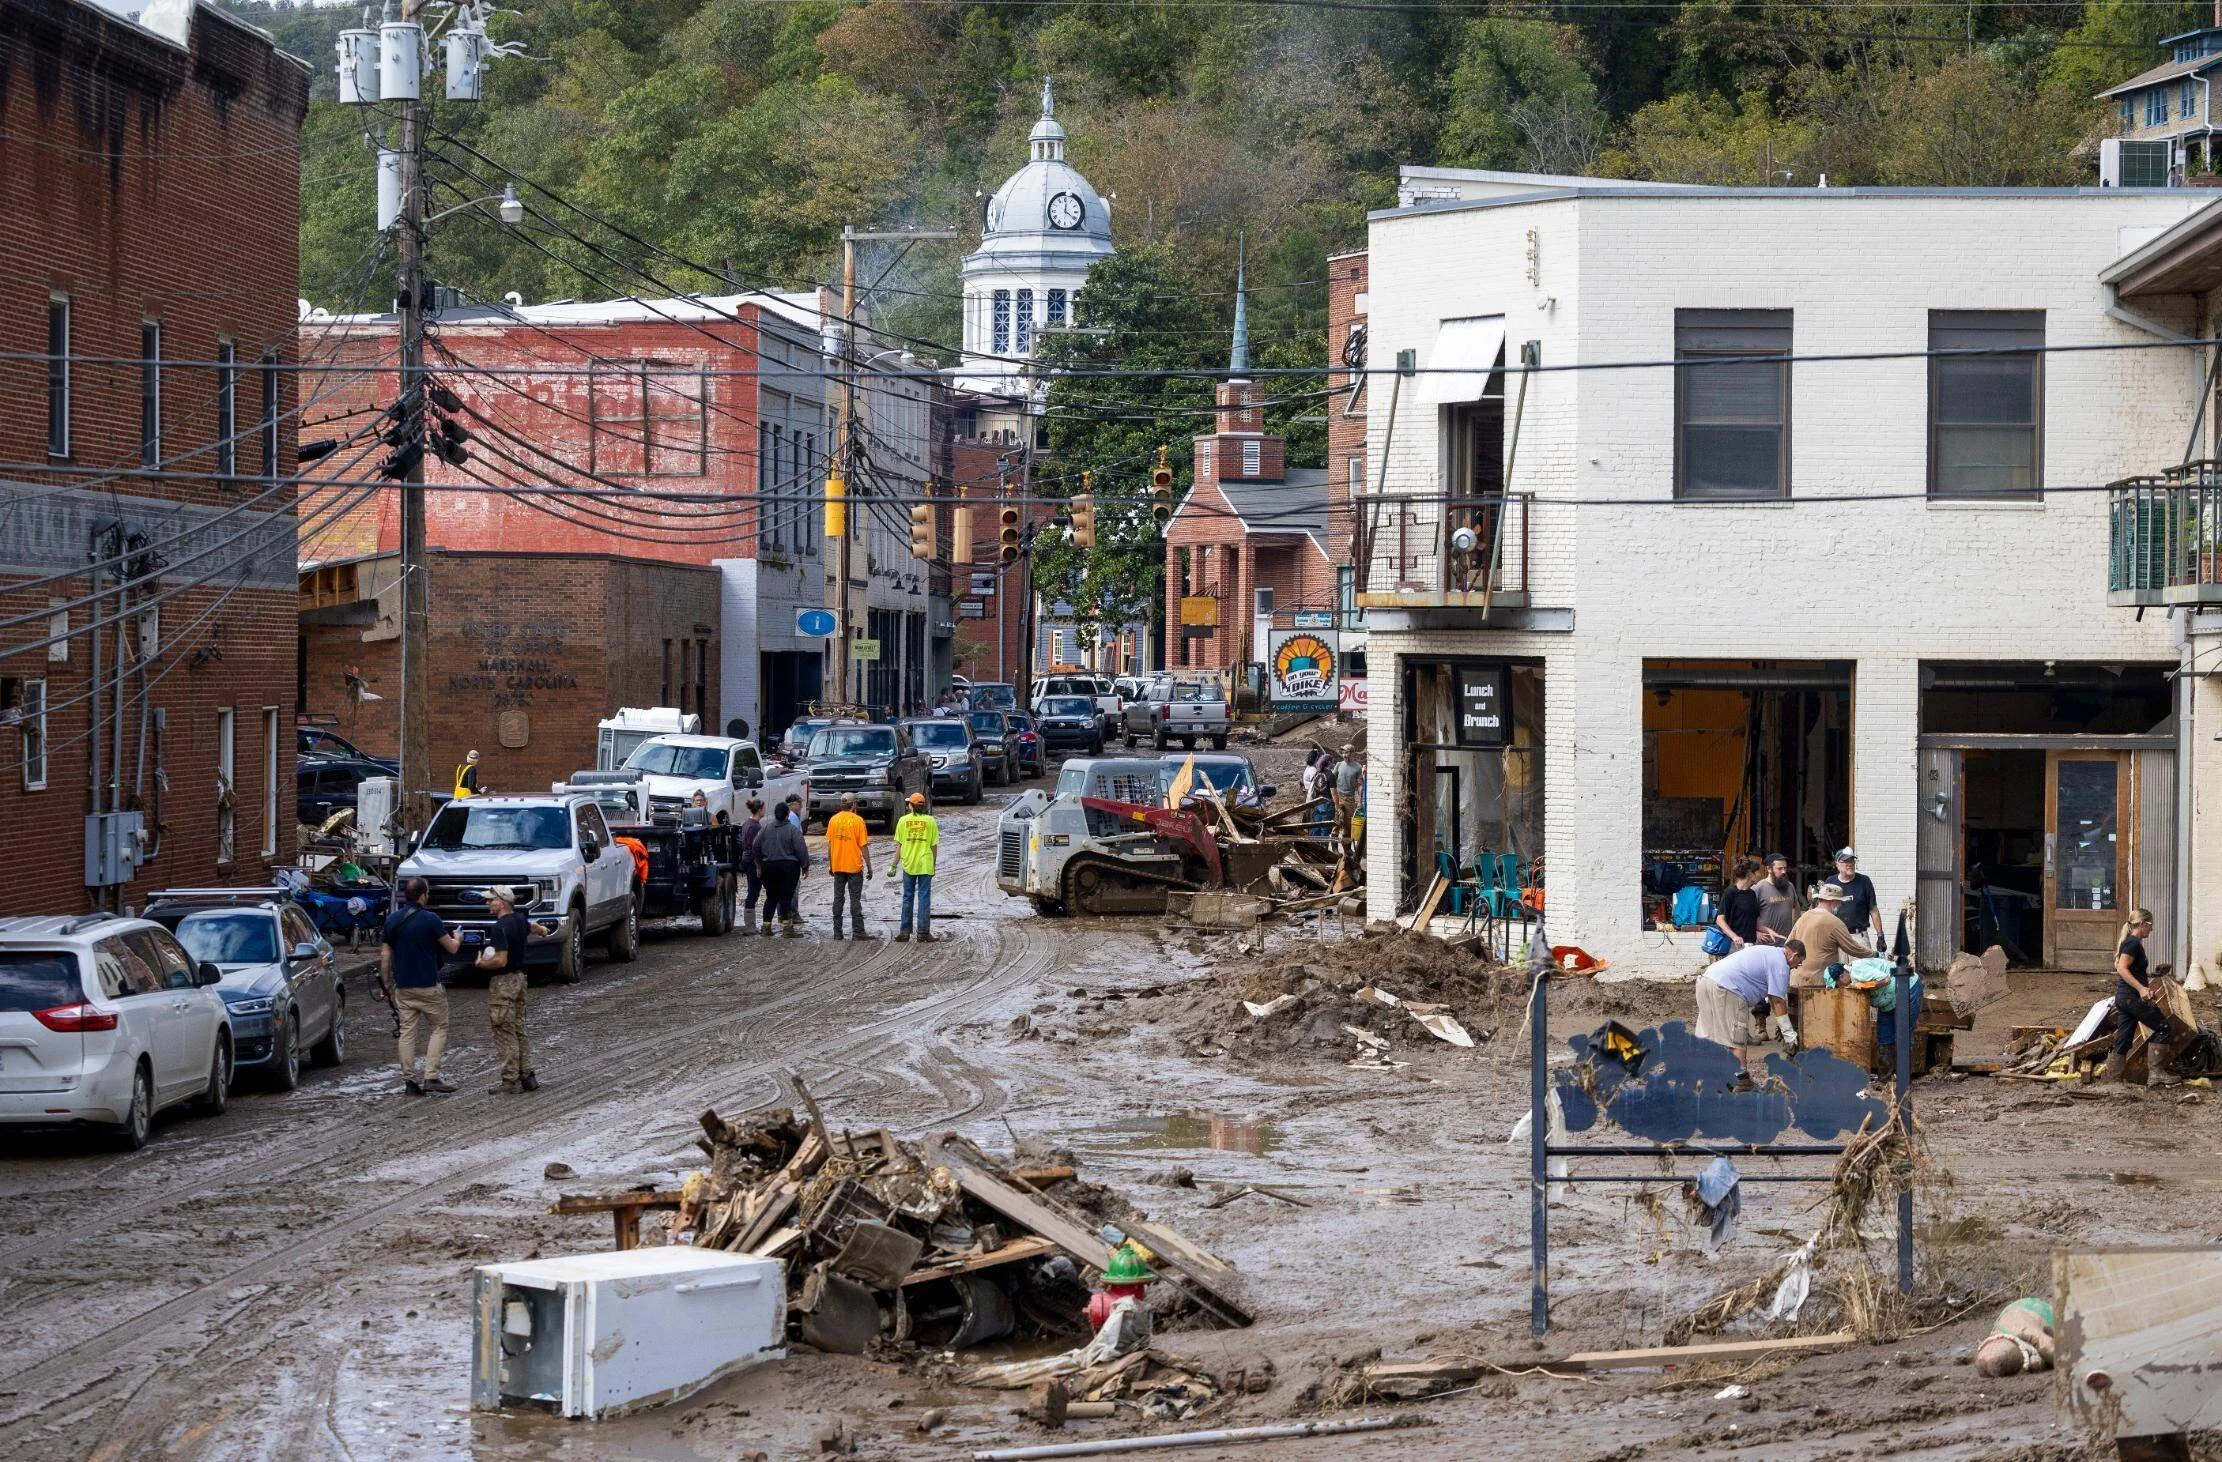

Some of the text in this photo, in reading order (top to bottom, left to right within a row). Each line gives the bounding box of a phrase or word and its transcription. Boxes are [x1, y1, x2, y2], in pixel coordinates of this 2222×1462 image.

[478, 659, 552, 673] MARSHALL
[507, 675, 577, 690] CAROLINA
[1291, 679, 1323, 692] BIKE
[1464, 684, 1494, 697] Lunch
[1474, 702, 1486, 710] and
[1464, 714, 1499, 728] Brunch
